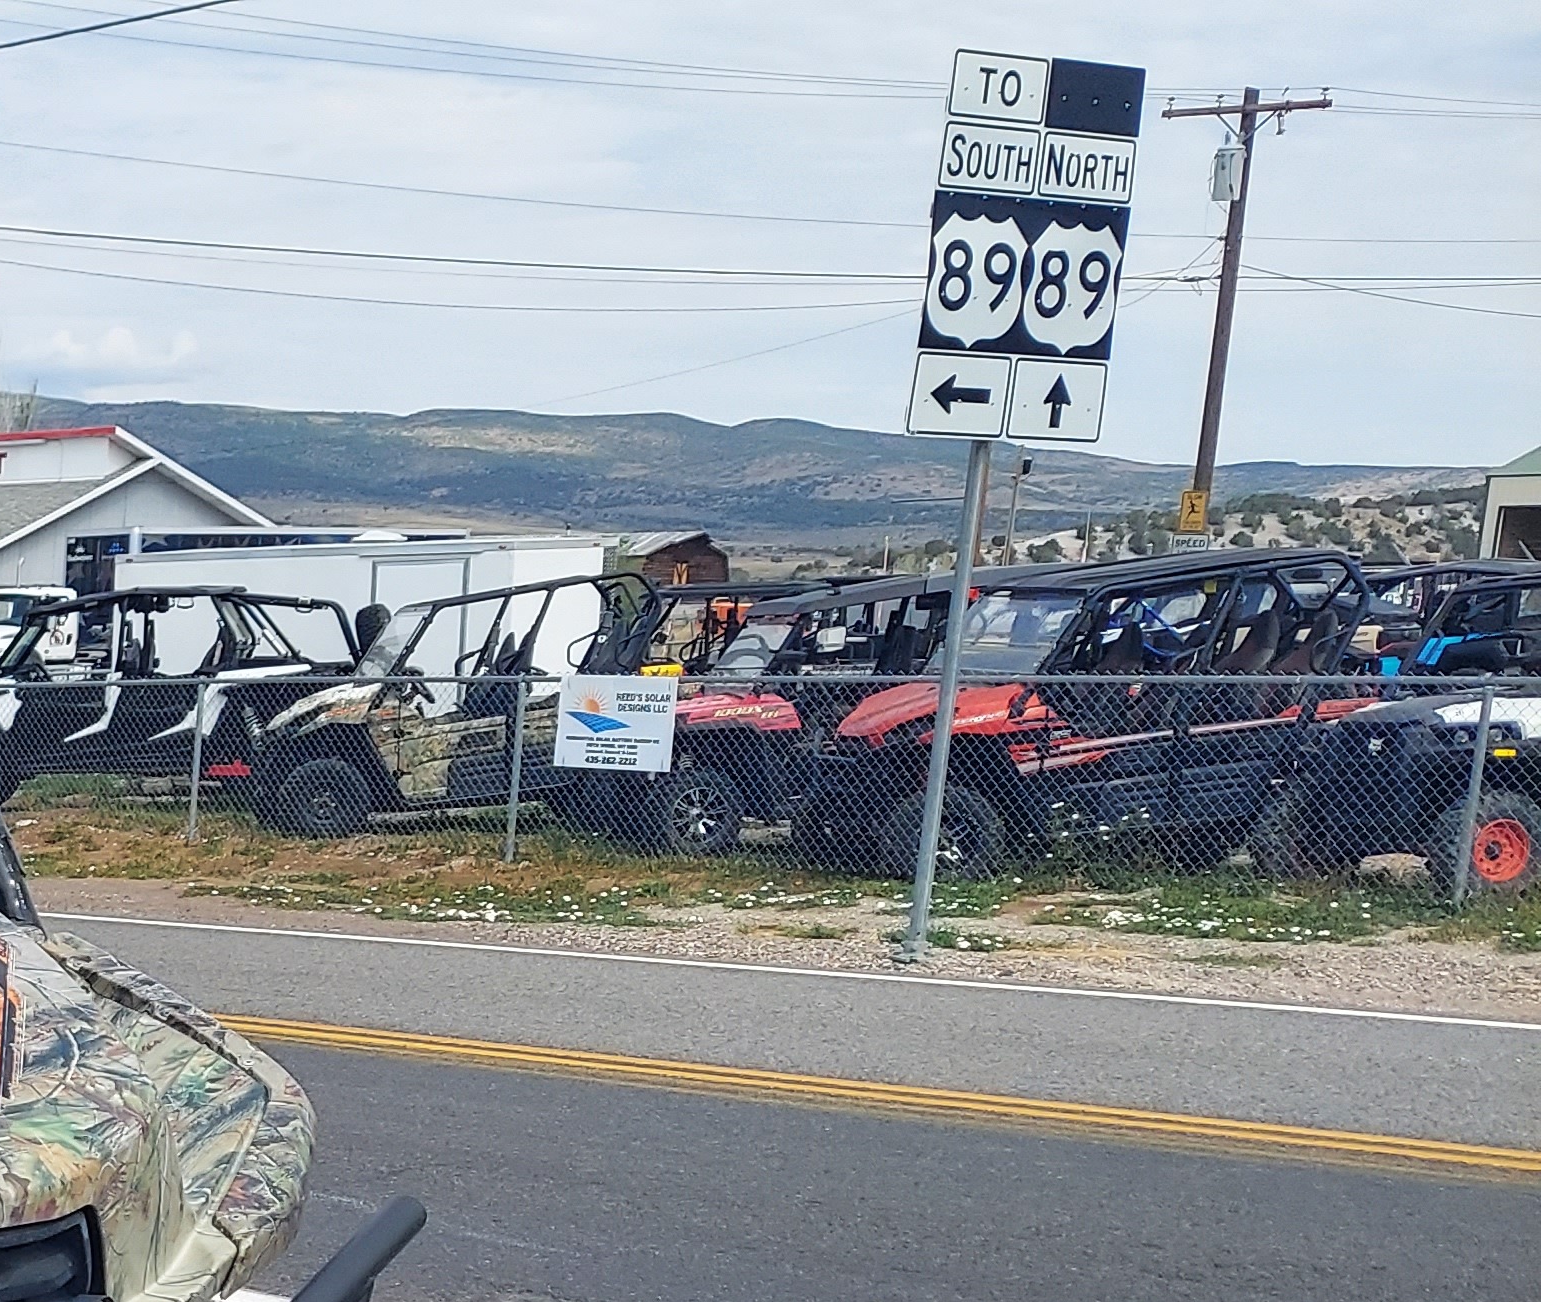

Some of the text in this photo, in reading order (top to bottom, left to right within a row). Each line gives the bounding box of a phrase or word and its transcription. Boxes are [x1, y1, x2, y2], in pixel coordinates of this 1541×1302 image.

[980, 66, 1022, 107] TO
[947, 133, 1034, 184] SOUTH
[1044, 143, 1130, 193] NORTH
[938, 239, 1018, 313] 89
[1034, 250, 1112, 320] 89
[1175, 538, 1206, 548] SPEED
[617, 703, 668, 714] DESIGNS LLC
[645, 693, 671, 703] SOLAR
